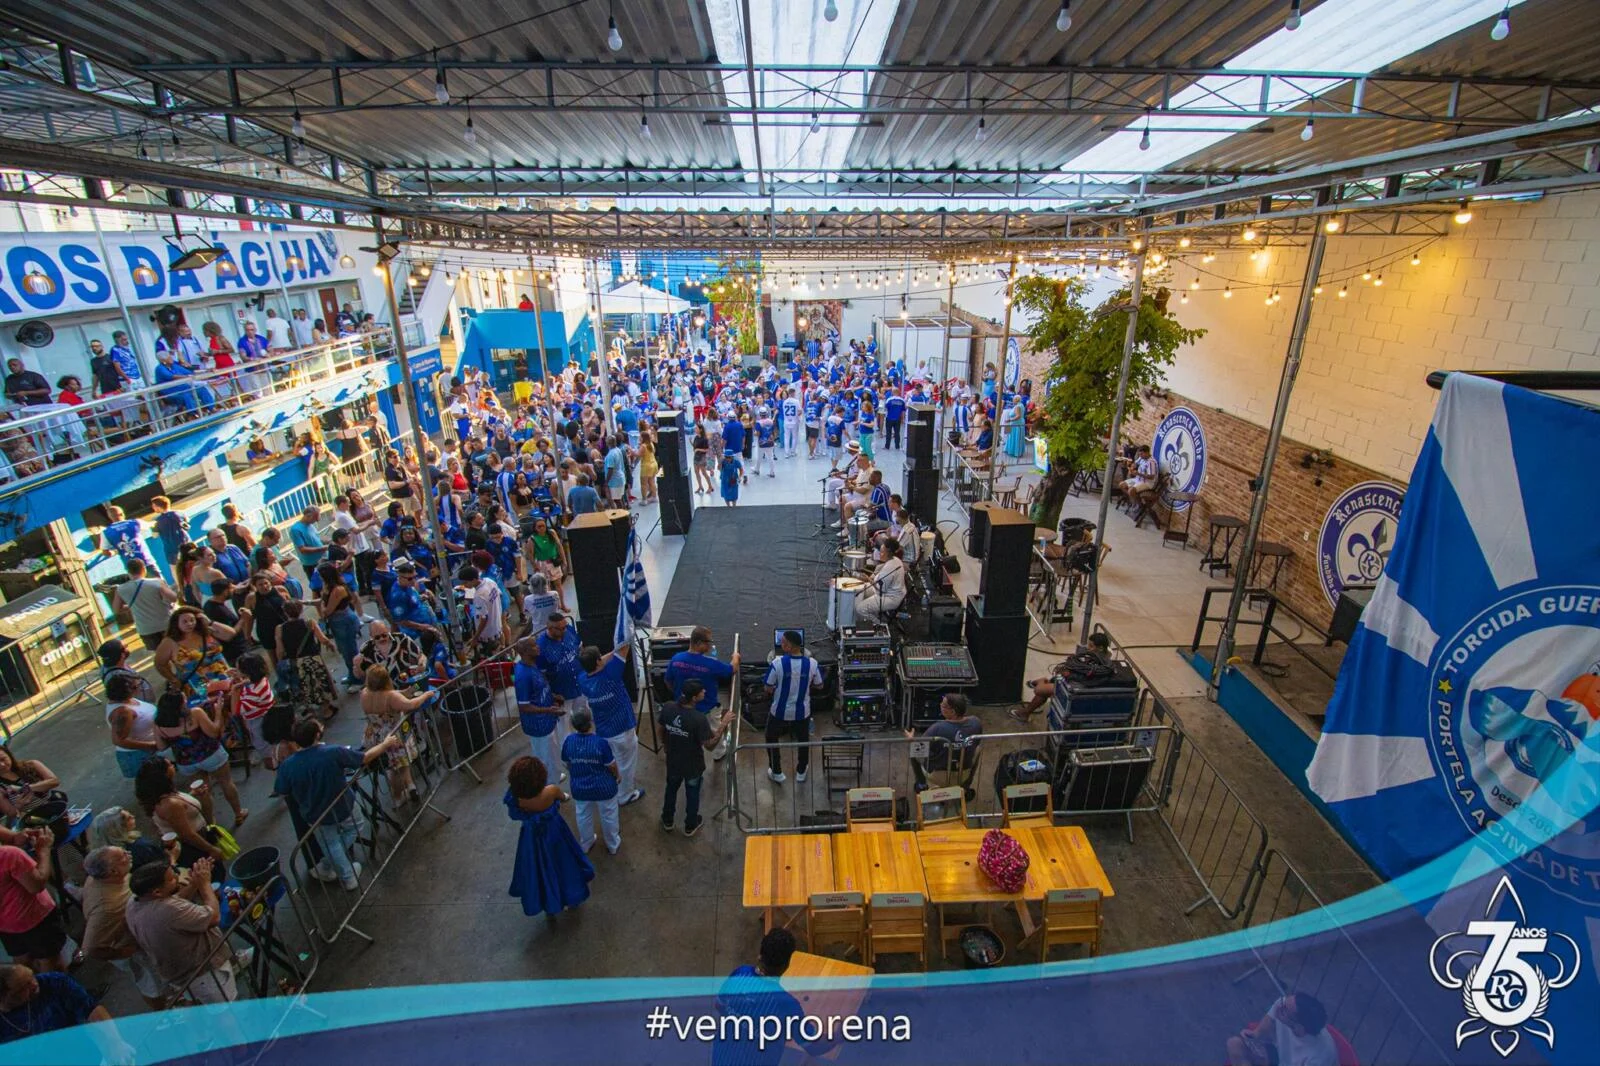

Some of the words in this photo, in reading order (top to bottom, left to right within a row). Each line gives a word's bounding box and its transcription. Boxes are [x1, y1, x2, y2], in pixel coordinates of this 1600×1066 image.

[120, 243, 204, 300] DA
[211, 231, 331, 290] ÁGUIA
[784, 405, 796, 416] 23
[1443, 603, 1533, 674] TORCIDA
[1437, 699, 1476, 805] PORTELA
[1471, 808, 1547, 871] ACIMA
[1551, 860, 1581, 887] DE
